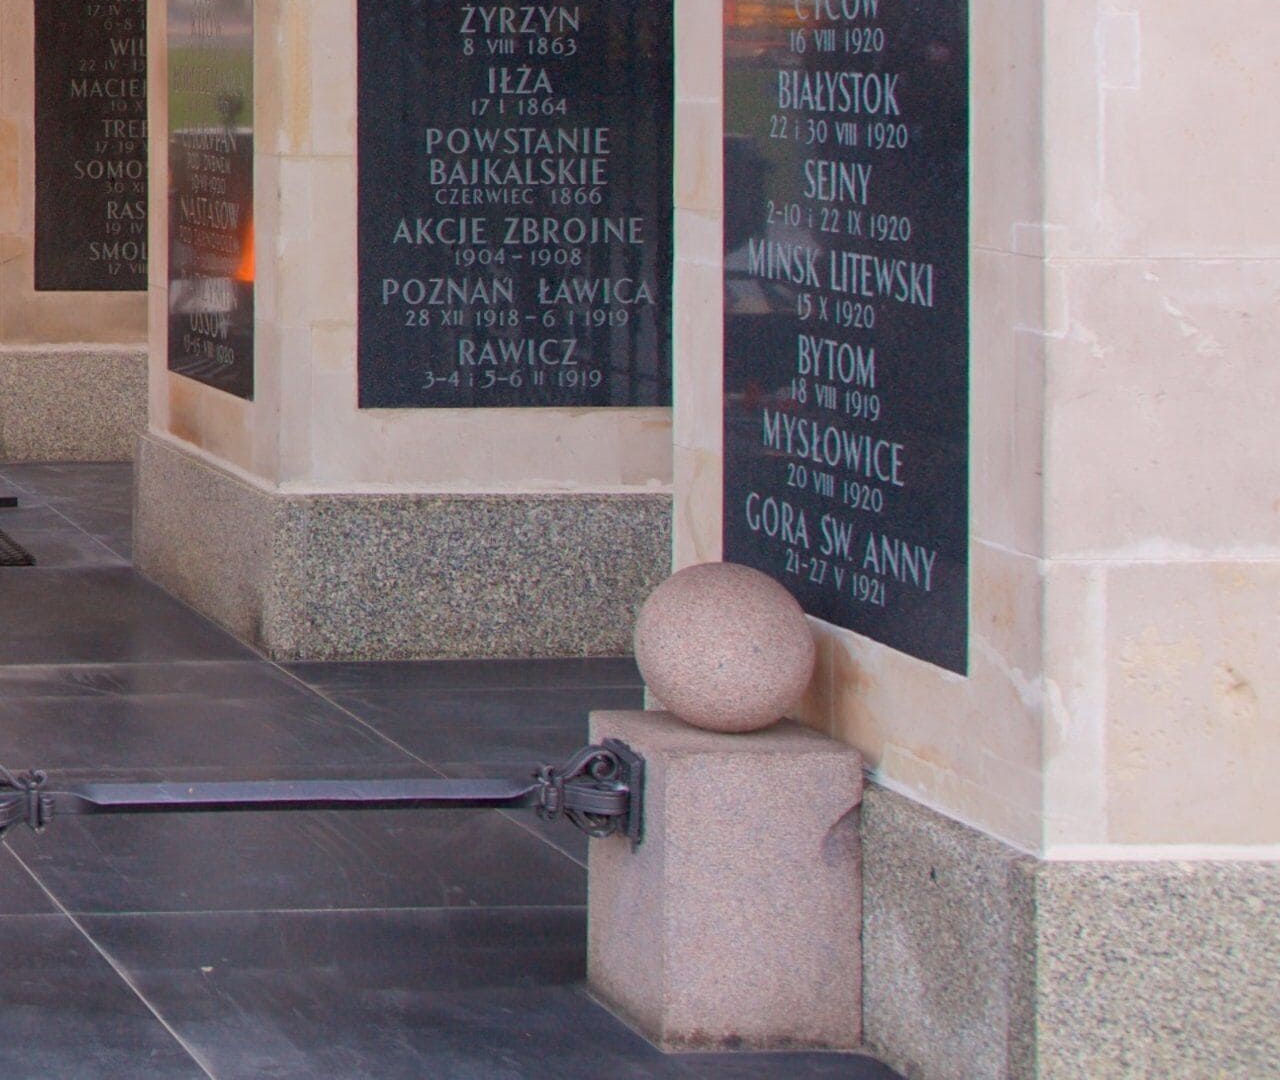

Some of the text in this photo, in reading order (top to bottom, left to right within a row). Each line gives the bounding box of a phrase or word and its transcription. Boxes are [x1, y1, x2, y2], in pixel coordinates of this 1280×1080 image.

[487, 39, 576, 55] VIII 1863
[814, 28, 884, 54] VIII 1920
[518, 98, 567, 115] 1864
[779, 71, 900, 115] BIAŁYSTOK
[426, 128, 610, 154] POWSTANIE
[836, 122, 908, 149] VIII 1920
[430, 159, 608, 185] BAJKALSKIE
[804, 159, 872, 205] SEJNY
[435, 188, 602, 205] CZERWIEC 1866
[393, 218, 644, 245] AKCJE ZBROJNE
[871, 215, 911, 241] 1920
[538, 278, 655, 304] ŁAWICA
[831, 251, 933, 307] LITEWSKI
[441, 309, 629, 327] XII 1918 1919
[837, 301, 874, 328] 1920
[460, 340, 578, 365] RAWICZ
[799, 335, 875, 388] BYTOM
[423, 370, 602, 389] 3-4 5-6 1919
[815, 383, 880, 421] VIII 1919
[763, 409, 904, 487] MYSŁOWICE
[813, 472, 883, 512] VIII 1920
[863, 532, 937, 591] ANNY
[853, 575, 885, 606] 1921
